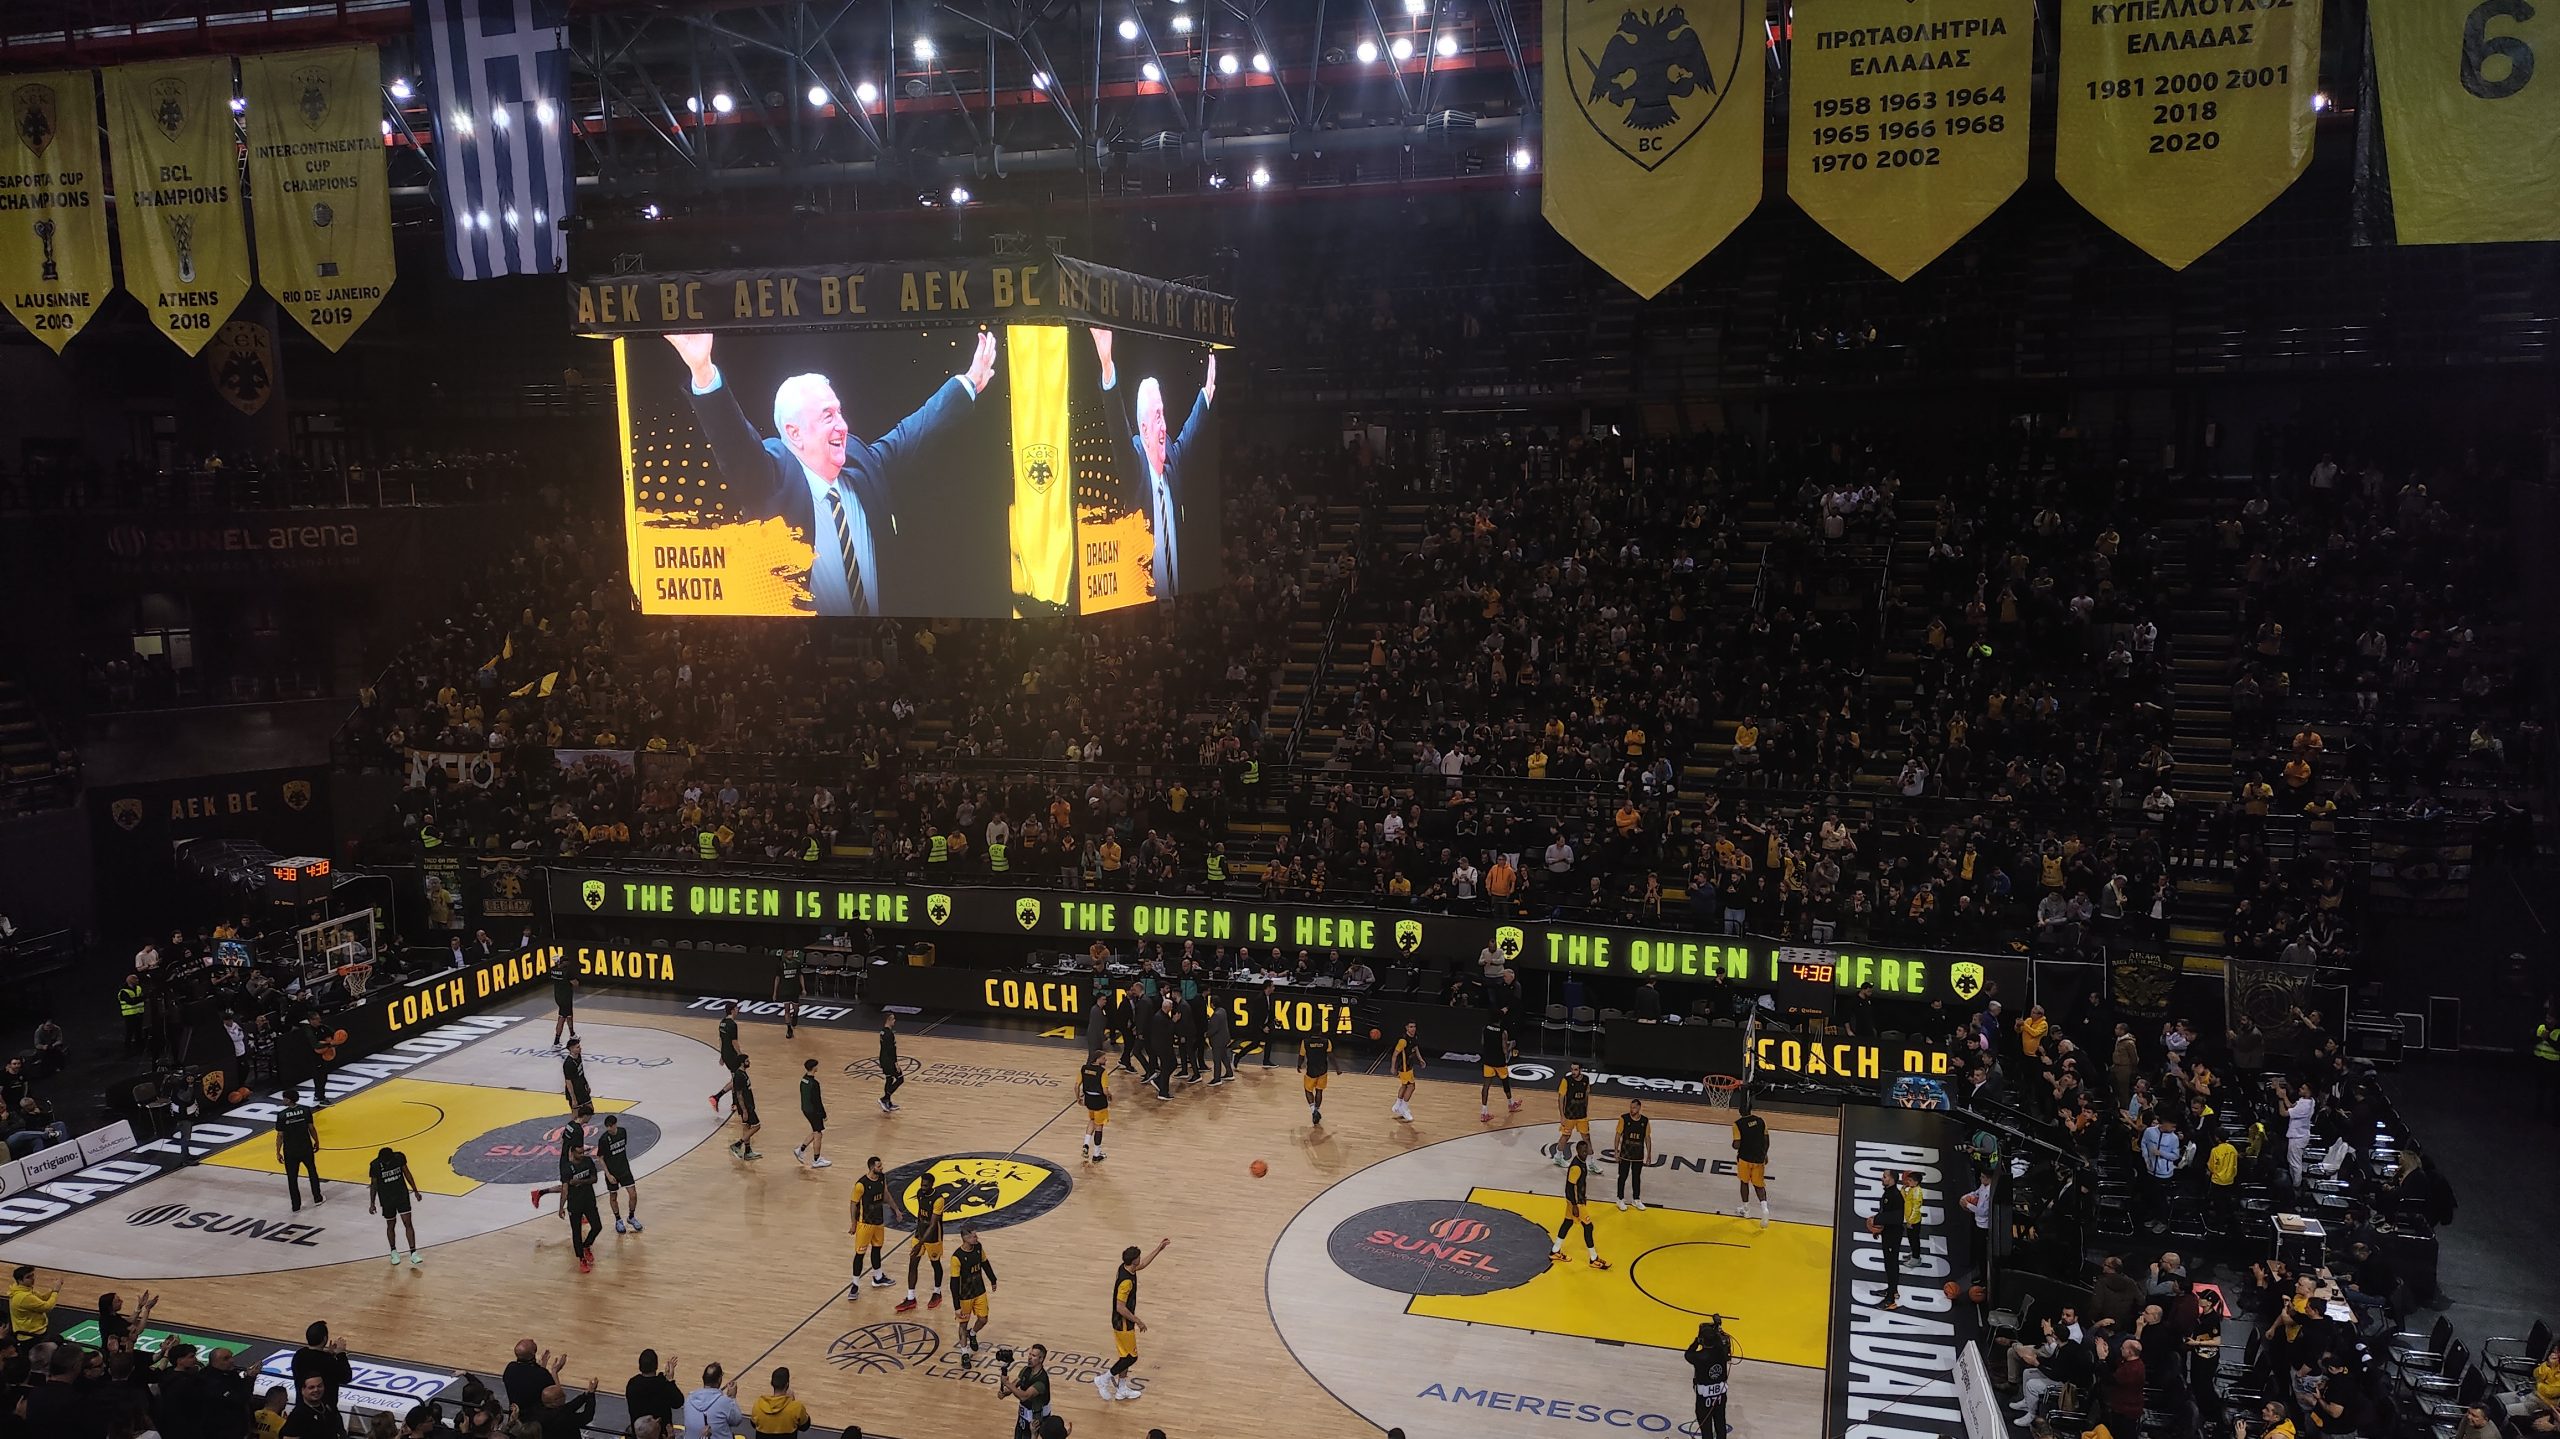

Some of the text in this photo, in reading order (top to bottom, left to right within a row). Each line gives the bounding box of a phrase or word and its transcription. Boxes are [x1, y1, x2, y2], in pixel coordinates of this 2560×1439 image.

[1817, 18, 2008, 51] ΠΡΩΤΑΘΛΗΤΡΙΑ
[2128, 24, 2253, 54] ΕΛΛΑΔΑΣ
[2460, 0, 2536, 99] 6
[1850, 49, 1971, 77] ΕΛΛΑΔΑΣ
[2087, 65, 2288, 100] 1981 2000 2001
[1813, 85, 2007, 119] 1958 1963 1964
[2153, 101, 2217, 124] 2018
[1812, 114, 2006, 147] 1965 1966 1968
[2149, 131, 2220, 153] 2020
[255, 137, 381, 159] INTERCONTINENTAL
[1639, 136, 1663, 153] BC
[306, 160, 331, 173] CUP
[1812, 147, 1941, 174] 1970 2002
[59, 172, 84, 187] CUP
[160, 165, 193, 183] BCL
[283, 176, 358, 193] CHAMPIONS
[0, 191, 90, 210] CHAMPIONS
[158, 291, 219, 308] ATHENS
[283, 287, 381, 304] RIO DE JANEIRO
[578, 266, 1040, 324] AEK BC AEK BC AEK BC
[1058, 268, 1236, 338] AEK BC AEK BC AEK BC
[35, 314, 73, 330] 2000
[169, 313, 211, 330] 2018
[311, 307, 353, 326] 2019
[267, 524, 358, 550] arena
[654, 546, 726, 569] DRAGAN
[1086, 541, 1119, 565] DRAGAN
[656, 576, 724, 601] SAKOTA
[1087, 574, 1118, 599] SAKOTA
[171, 791, 259, 820] AEK BC
[273, 866, 298, 882] 4:38
[305, 859, 331, 878] 4:38
[624, 884, 909, 922] THE QUEEN IS HERE
[1061, 902, 1375, 950] THE QUEEN IS HERE
[1547, 932, 1610, 968] THE
[1631, 940, 1748, 979] QUEEN
[1793, 964, 1833, 983] 4:38
[387, 946, 675, 1031] COACH DRAGAN SAKOTA
[985, 978, 1078, 1013] COACH
[1236, 997, 1352, 1035] SKOTA
[930, 1062, 1050, 1079] BASKETBALL
[1758, 1038, 1879, 1079] COACH
[912, 1075, 991, 1088] LEAGUE
[921, 1069, 1062, 1088] CHAMPIONS
[27, 1150, 79, 1177] l'artigiano:
[172, 1211, 326, 1247] SUNEL
[1353, 1242, 1493, 1282] Empowering Change
[1367, 1230, 1500, 1273] SUNEL
[1708, 1384, 1721, 1395] HB
[1416, 1383, 1672, 1432] AMERESCO
